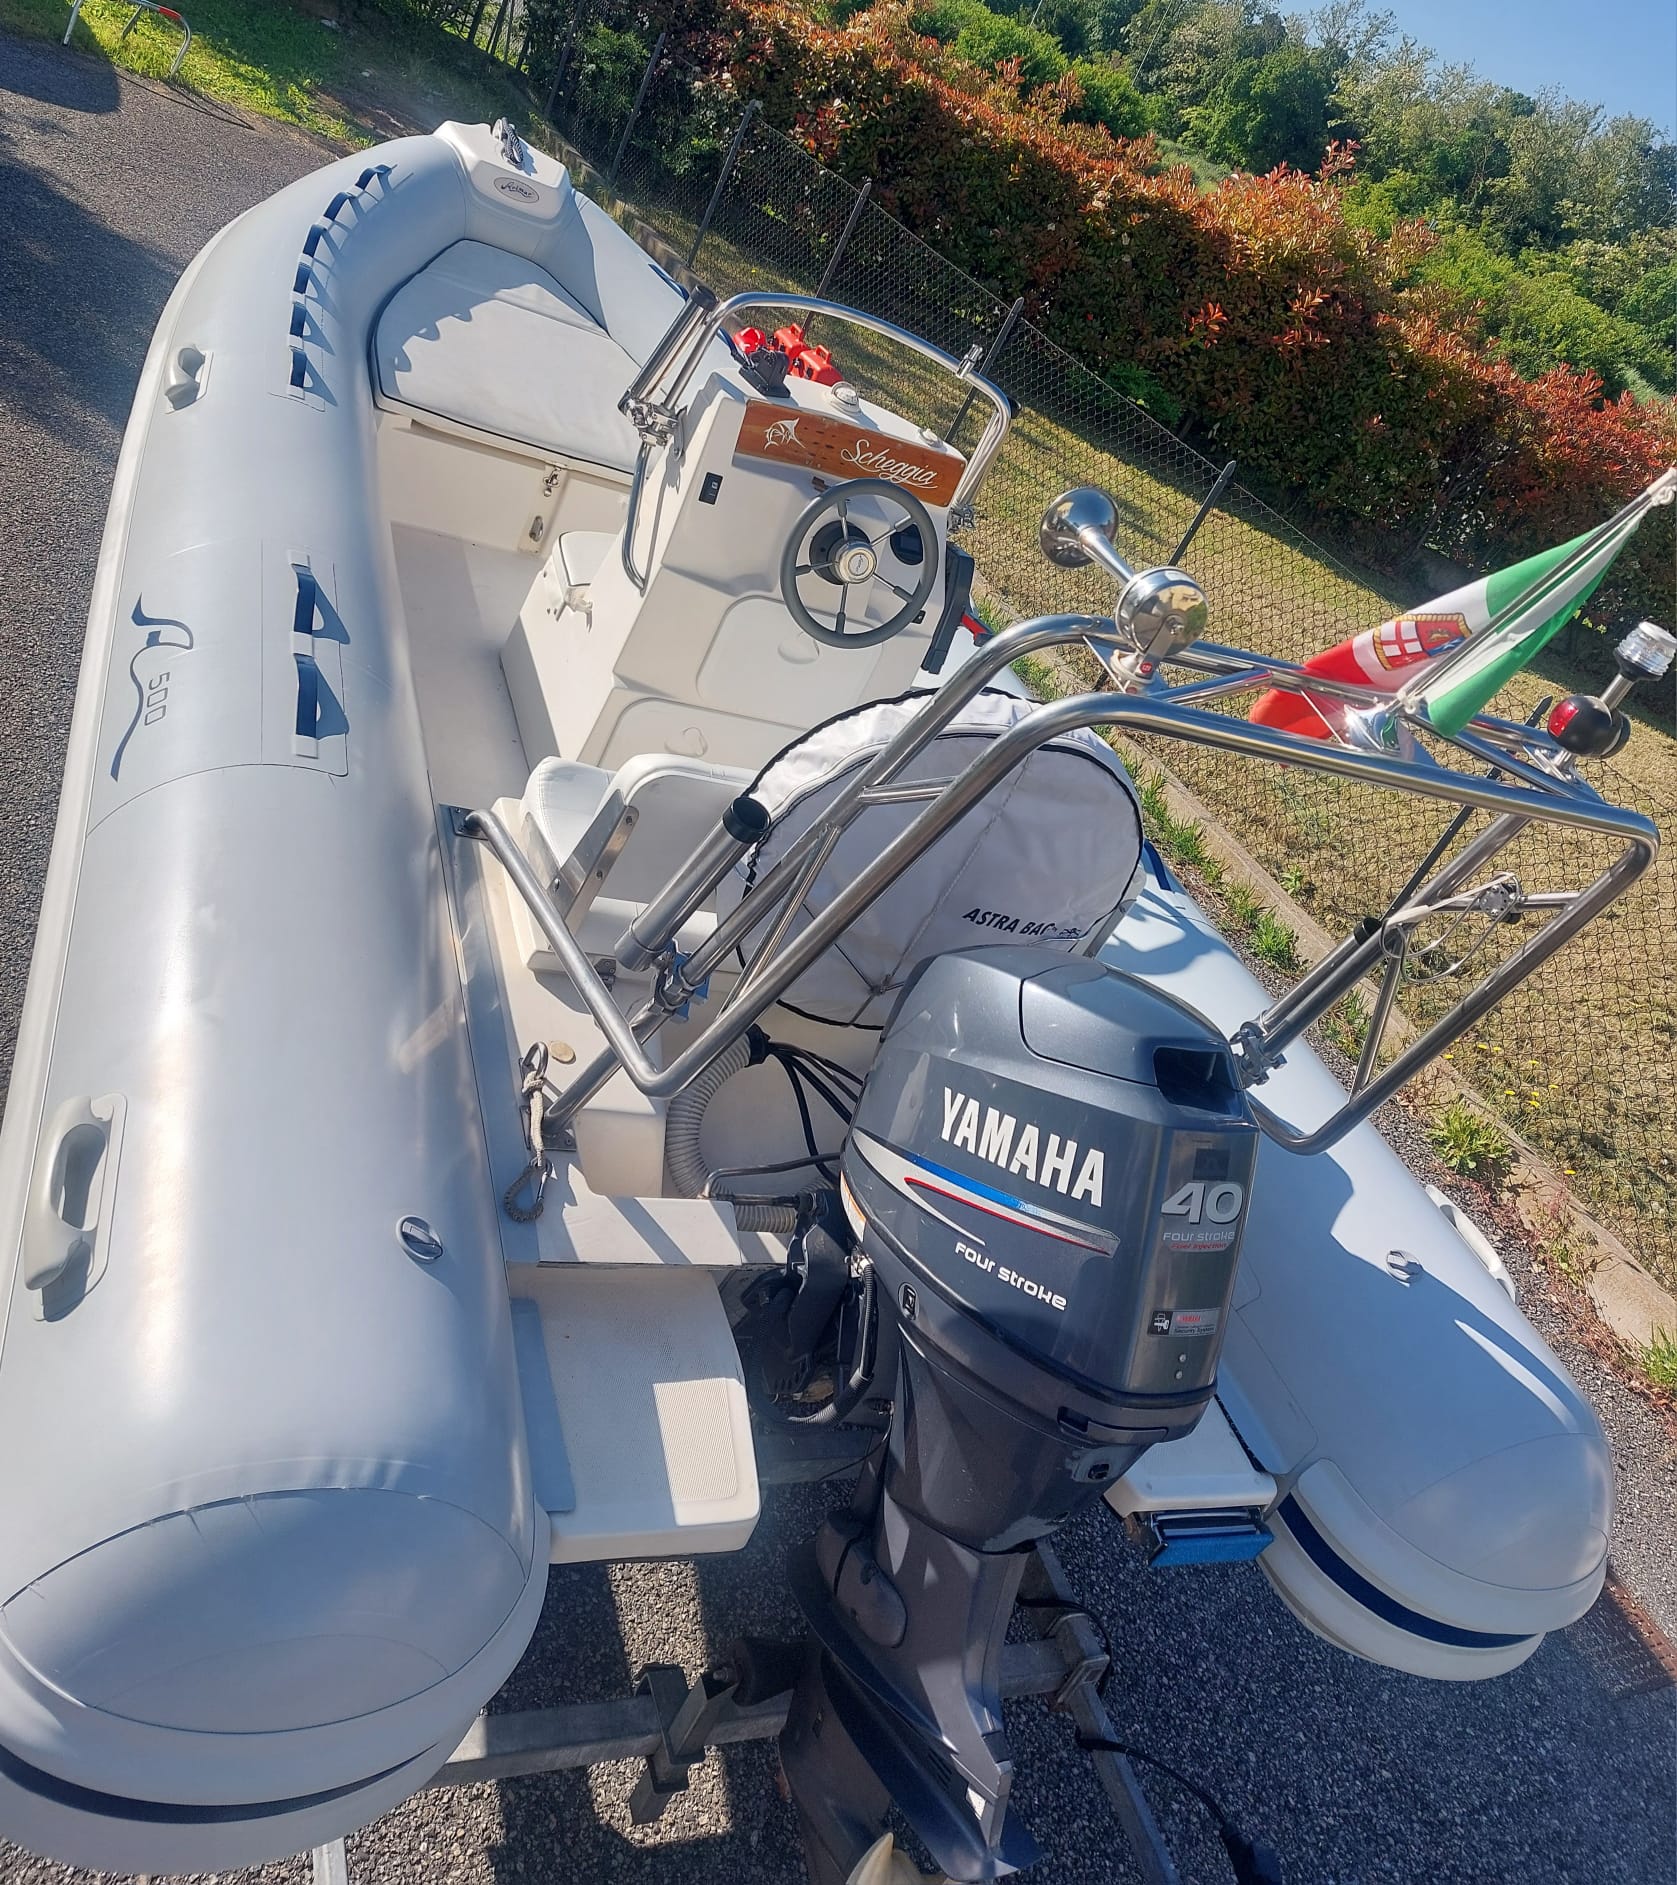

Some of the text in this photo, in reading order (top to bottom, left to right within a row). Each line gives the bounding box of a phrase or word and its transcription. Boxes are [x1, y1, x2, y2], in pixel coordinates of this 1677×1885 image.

[840, 439, 938, 489] Scheggia
[144, 671, 171, 727] 500
[962, 907, 1021, 934] ASTRA
[941, 1086, 1105, 1208] YAMAHA
[1161, 1182, 1244, 1225] 40
